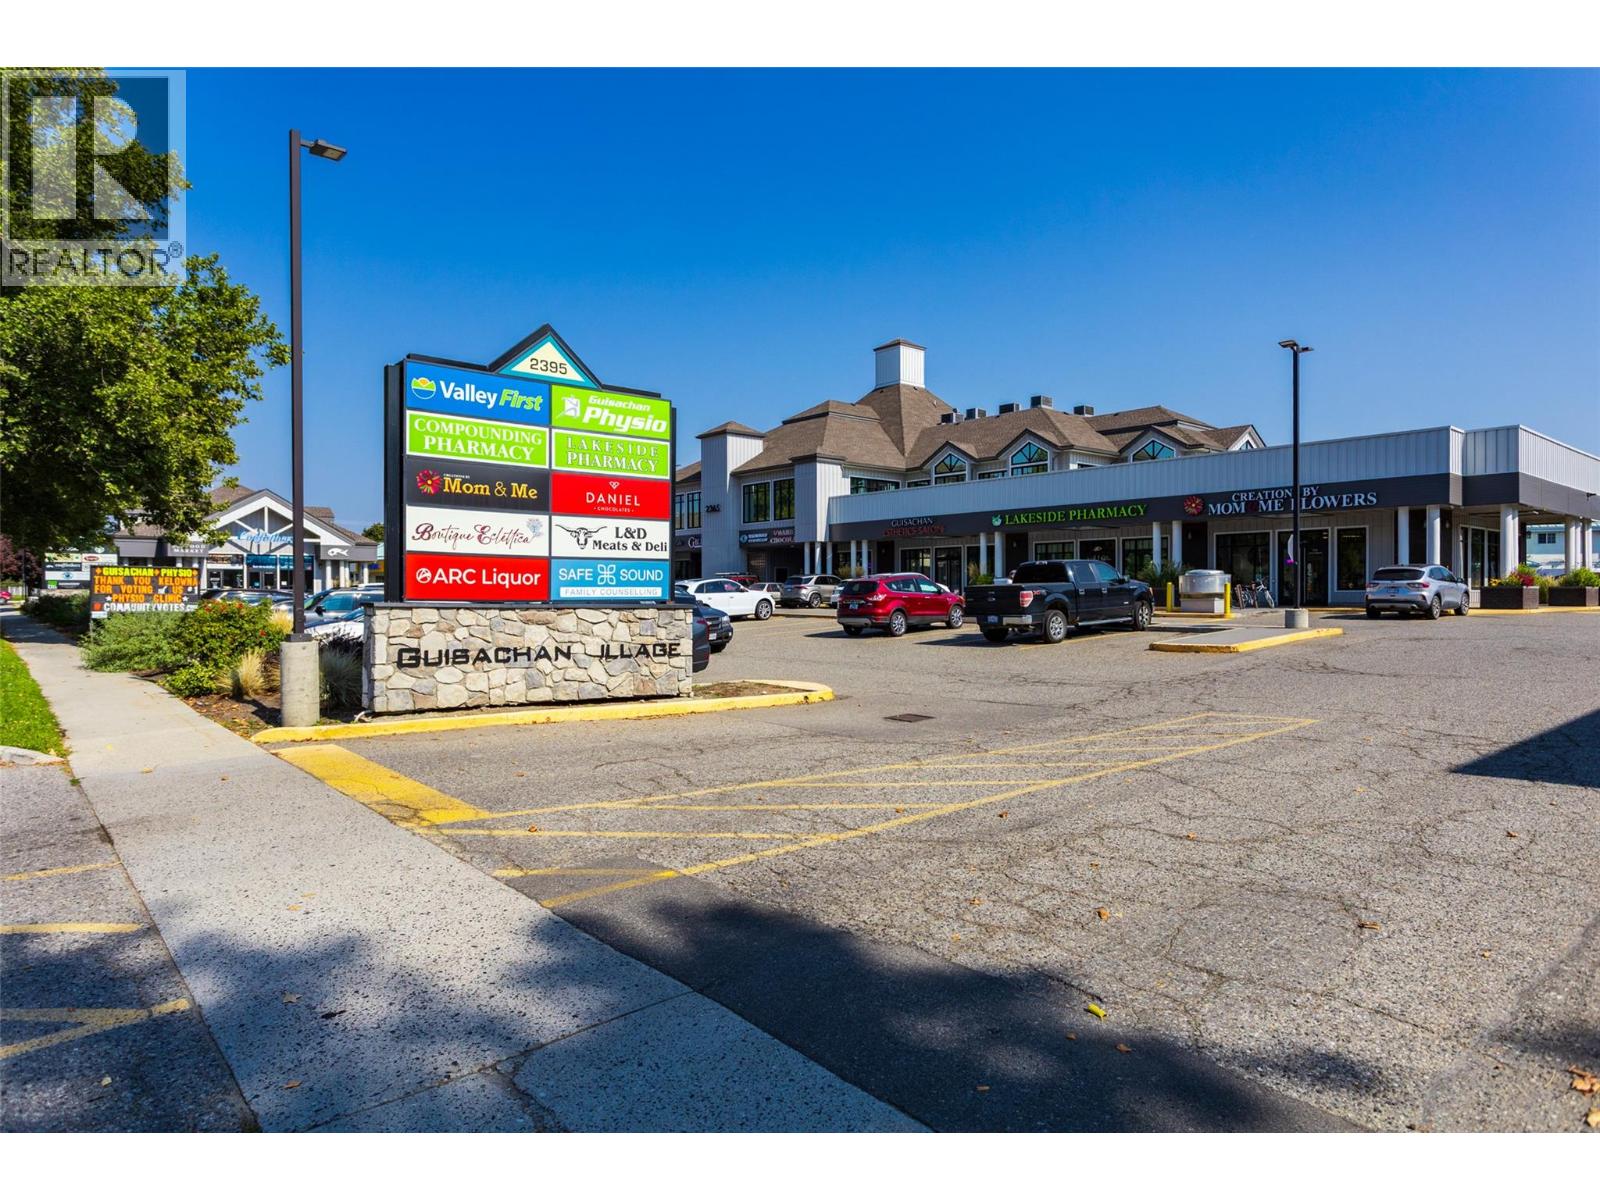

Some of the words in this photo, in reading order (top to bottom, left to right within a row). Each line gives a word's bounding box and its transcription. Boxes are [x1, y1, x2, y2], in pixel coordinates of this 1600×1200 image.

[529, 358, 568, 374] 2395
[440, 380, 498, 409] Valley
[499, 389, 543, 412] First
[588, 395, 651, 412] Guisachan
[582, 406, 667, 433] Physio
[414, 418, 542, 445] COMPOUNDING
[423, 435, 535, 460] PHARMACY
[567, 437, 658, 457] LAKESIDE
[567, 451, 658, 472] PHARMACY
[443, 477, 490, 496] Mom
[494, 481, 507, 497] &
[510, 482, 538, 499] Me
[1303, 486, 1320, 497] BY
[586, 492, 640, 506] DANIEL
[1005, 511, 1066, 525] LAKESIDE
[1069, 505, 1147, 521] PHARMACY
[1208, 502, 1246, 516] MOM
[1258, 500, 1284, 513] ME
[411, 522, 474, 550] Boutique
[615, 526, 647, 540] L&D
[592, 540, 628, 551] Meats
[631, 541, 642, 552] &
[645, 541, 668, 552] Deli
[103, 567, 153, 576] GUISACHAN
[161, 568, 193, 577] PHYSIO
[432, 568, 477, 585] ARC
[481, 568, 541, 589] Liquor
[558, 568, 594, 581] SAFE
[620, 569, 664, 581] SOUND
[94, 576, 124, 585] THANK
[134, 577, 151, 585] YOU
[159, 577, 198, 586] KELOWNA
[94, 585, 113, 594] FOR
[121, 585, 153, 594] VOTING
[172, 586, 184, 594] US
[564, 587, 597, 596] FAMILY
[599, 587, 658, 596] COUNSELLING
[112, 594, 145, 603] PHYSIO
[153, 594, 182, 603] CLINIC
[397, 645, 572, 668] GUISACHAN
